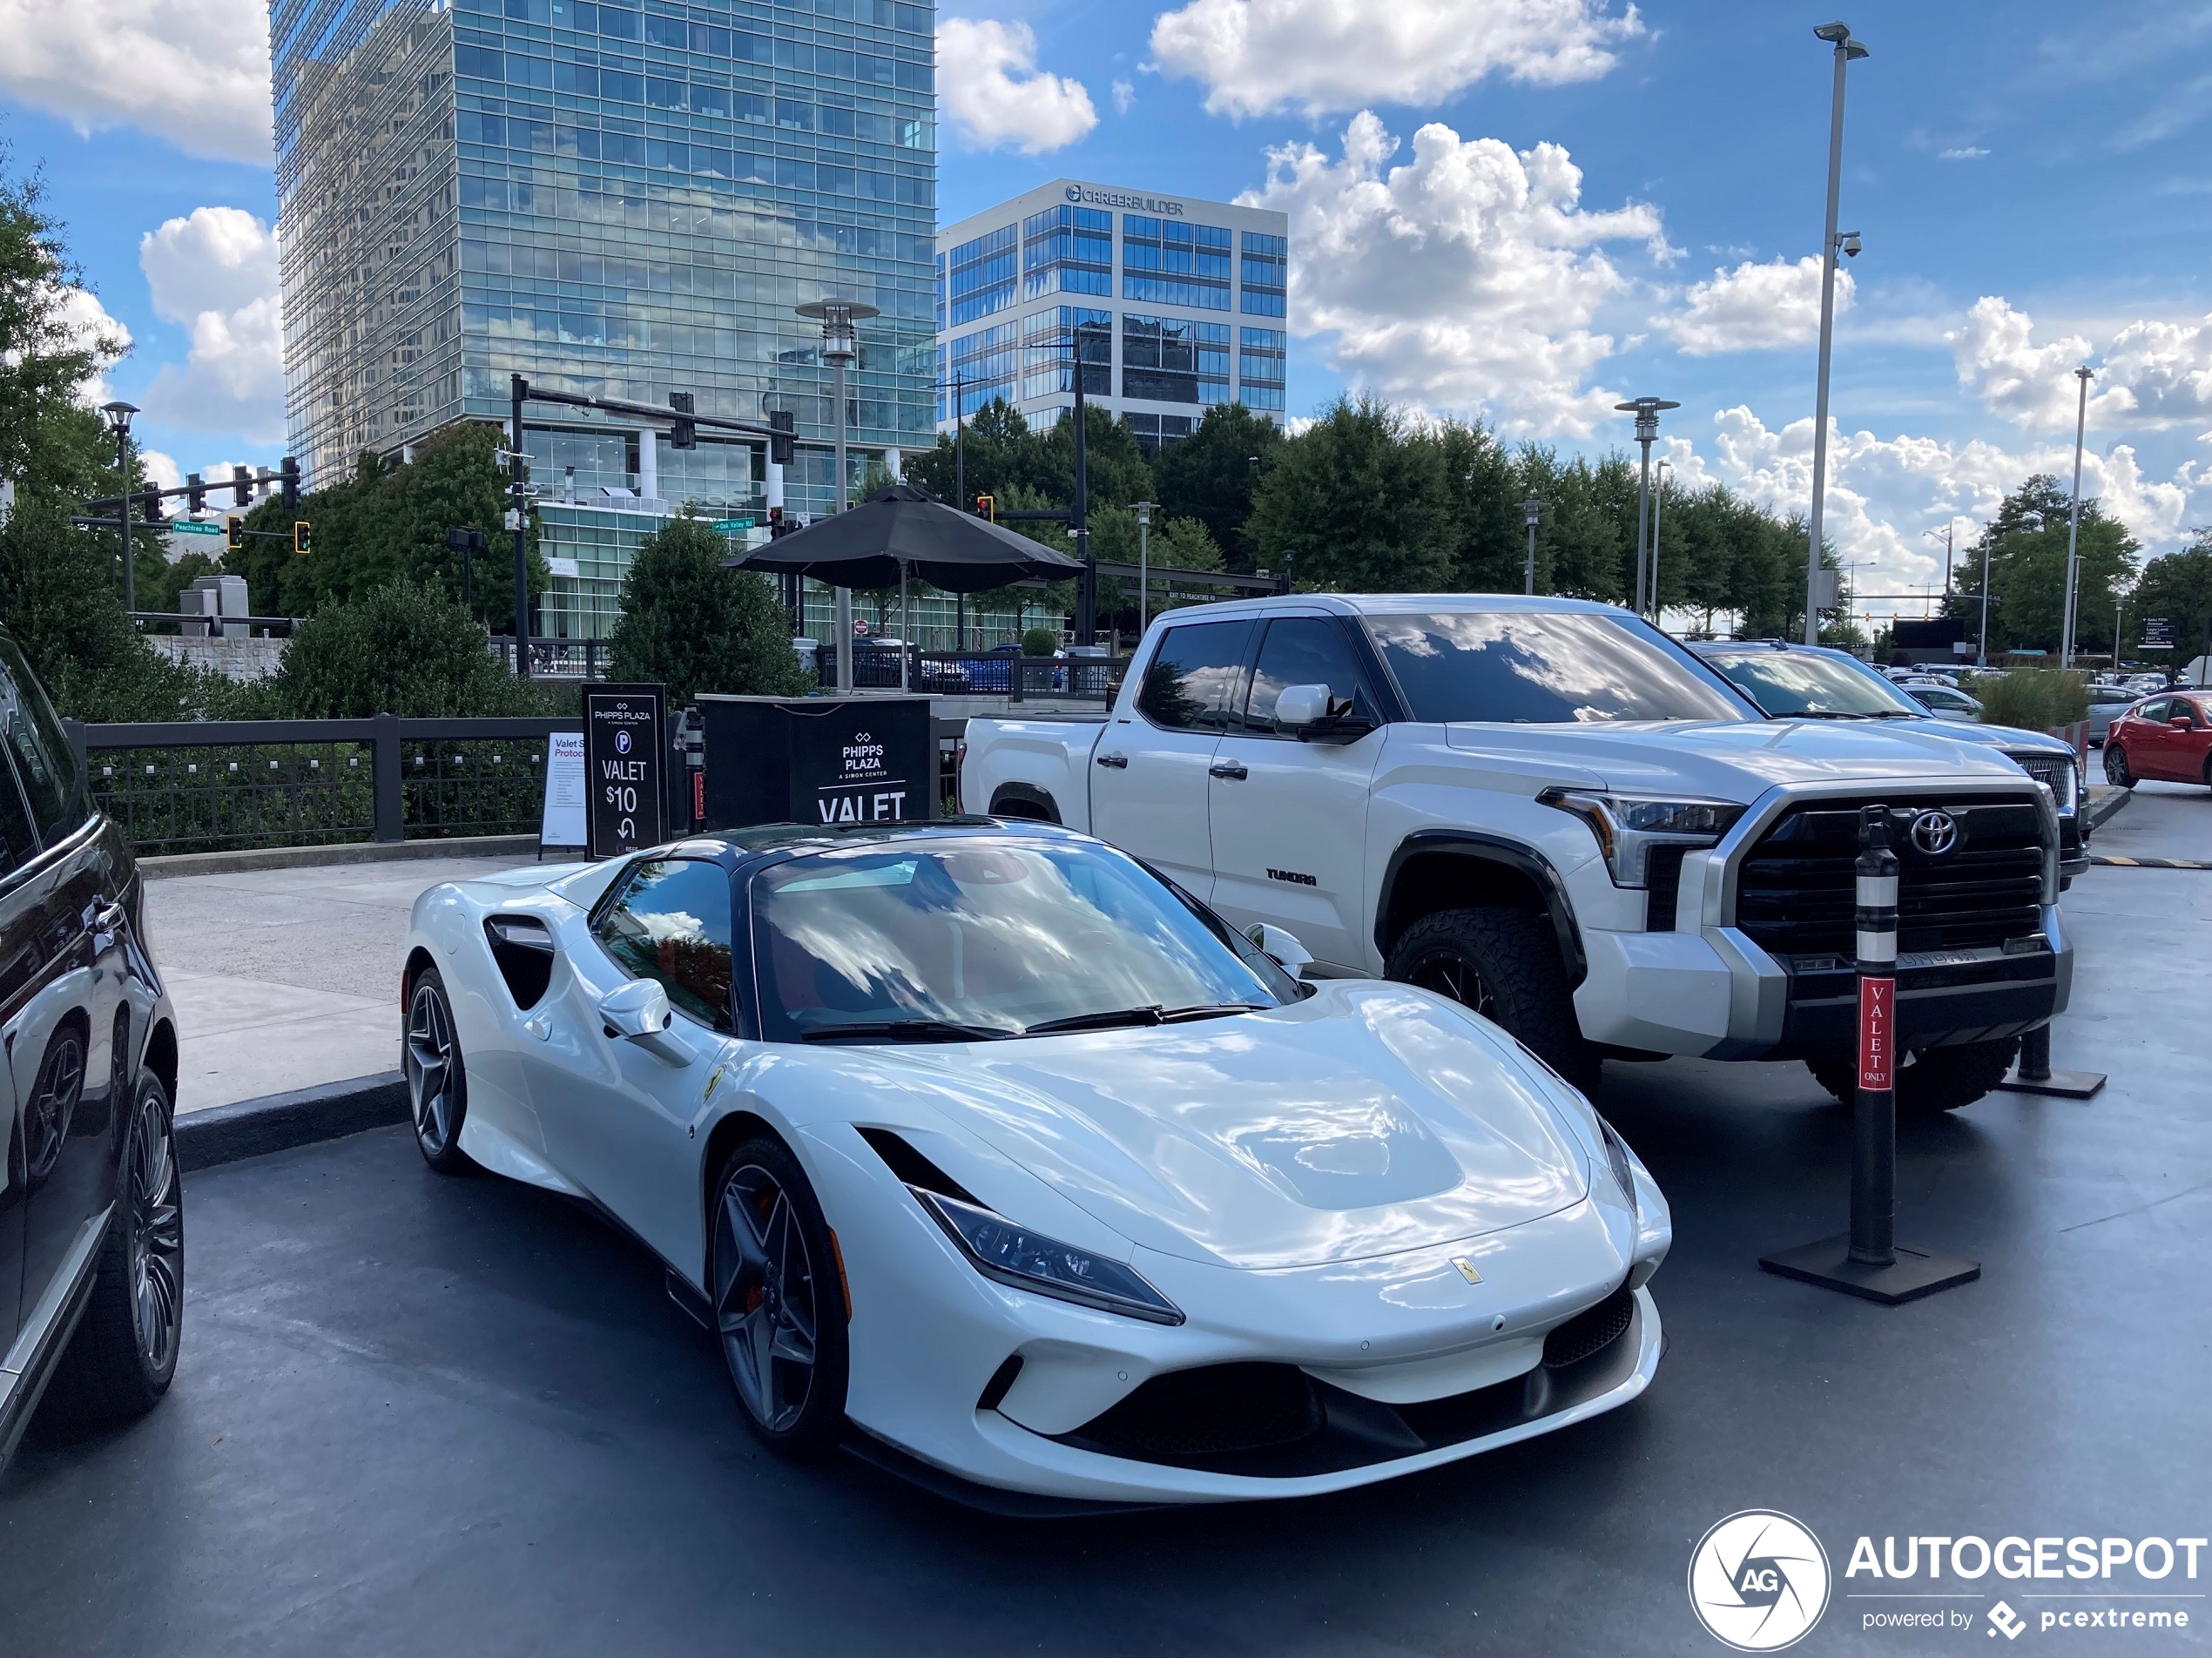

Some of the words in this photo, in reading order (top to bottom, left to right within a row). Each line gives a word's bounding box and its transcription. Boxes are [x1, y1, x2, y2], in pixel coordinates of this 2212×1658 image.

[595, 711, 623, 719] PHIPPS
[555, 739, 577, 748] Valet
[843, 745, 884, 758] PHIPPS
[602, 759, 647, 781] VALET
[846, 758, 881, 771] PLAZA
[606, 785, 637, 812] $10
[1265, 867, 1318, 886] TUNDRA
[1870, 987, 1885, 1069] VALET
[1865, 1072, 1886, 1081] ONLY
